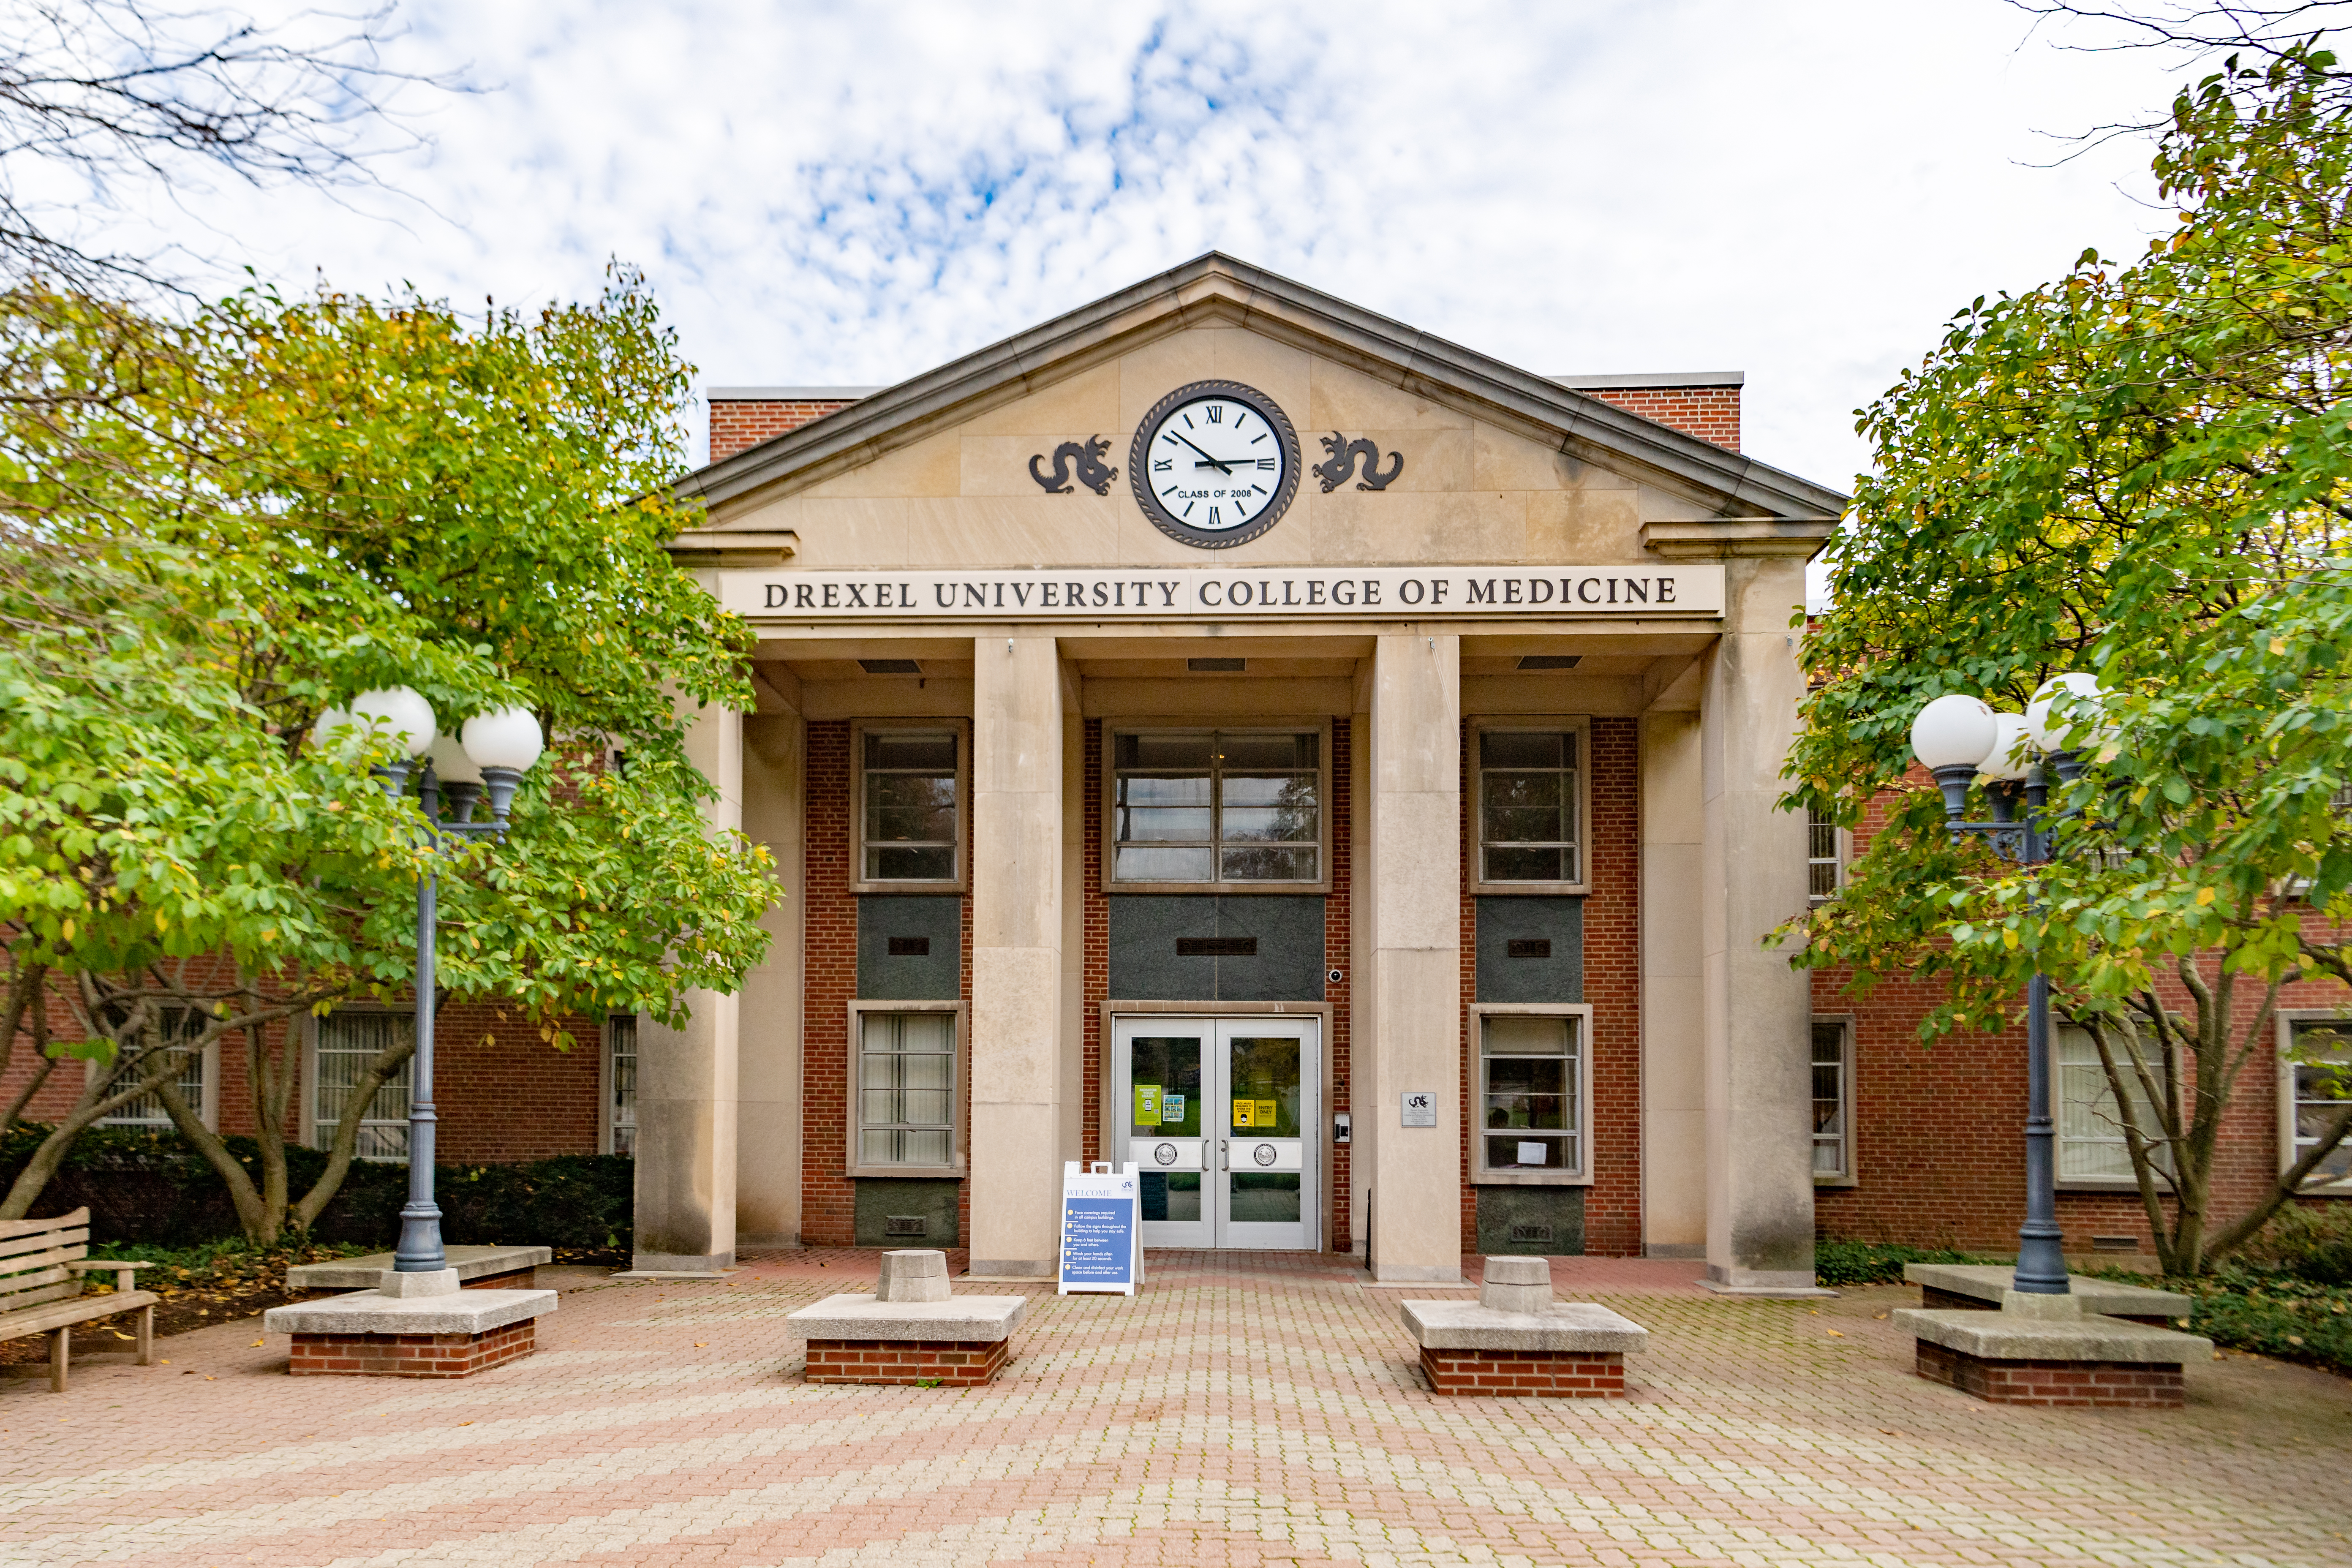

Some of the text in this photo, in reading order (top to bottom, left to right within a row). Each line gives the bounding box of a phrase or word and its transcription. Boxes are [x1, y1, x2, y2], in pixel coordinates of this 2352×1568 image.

[1206, 406, 1222, 424] XII
[1178, 490, 1209, 498] CLASS
[1231, 490, 1251, 498] 2008
[764, 578, 1676, 608] DREXEL UNIVERSITY COLLEGE OF MEDICINE
